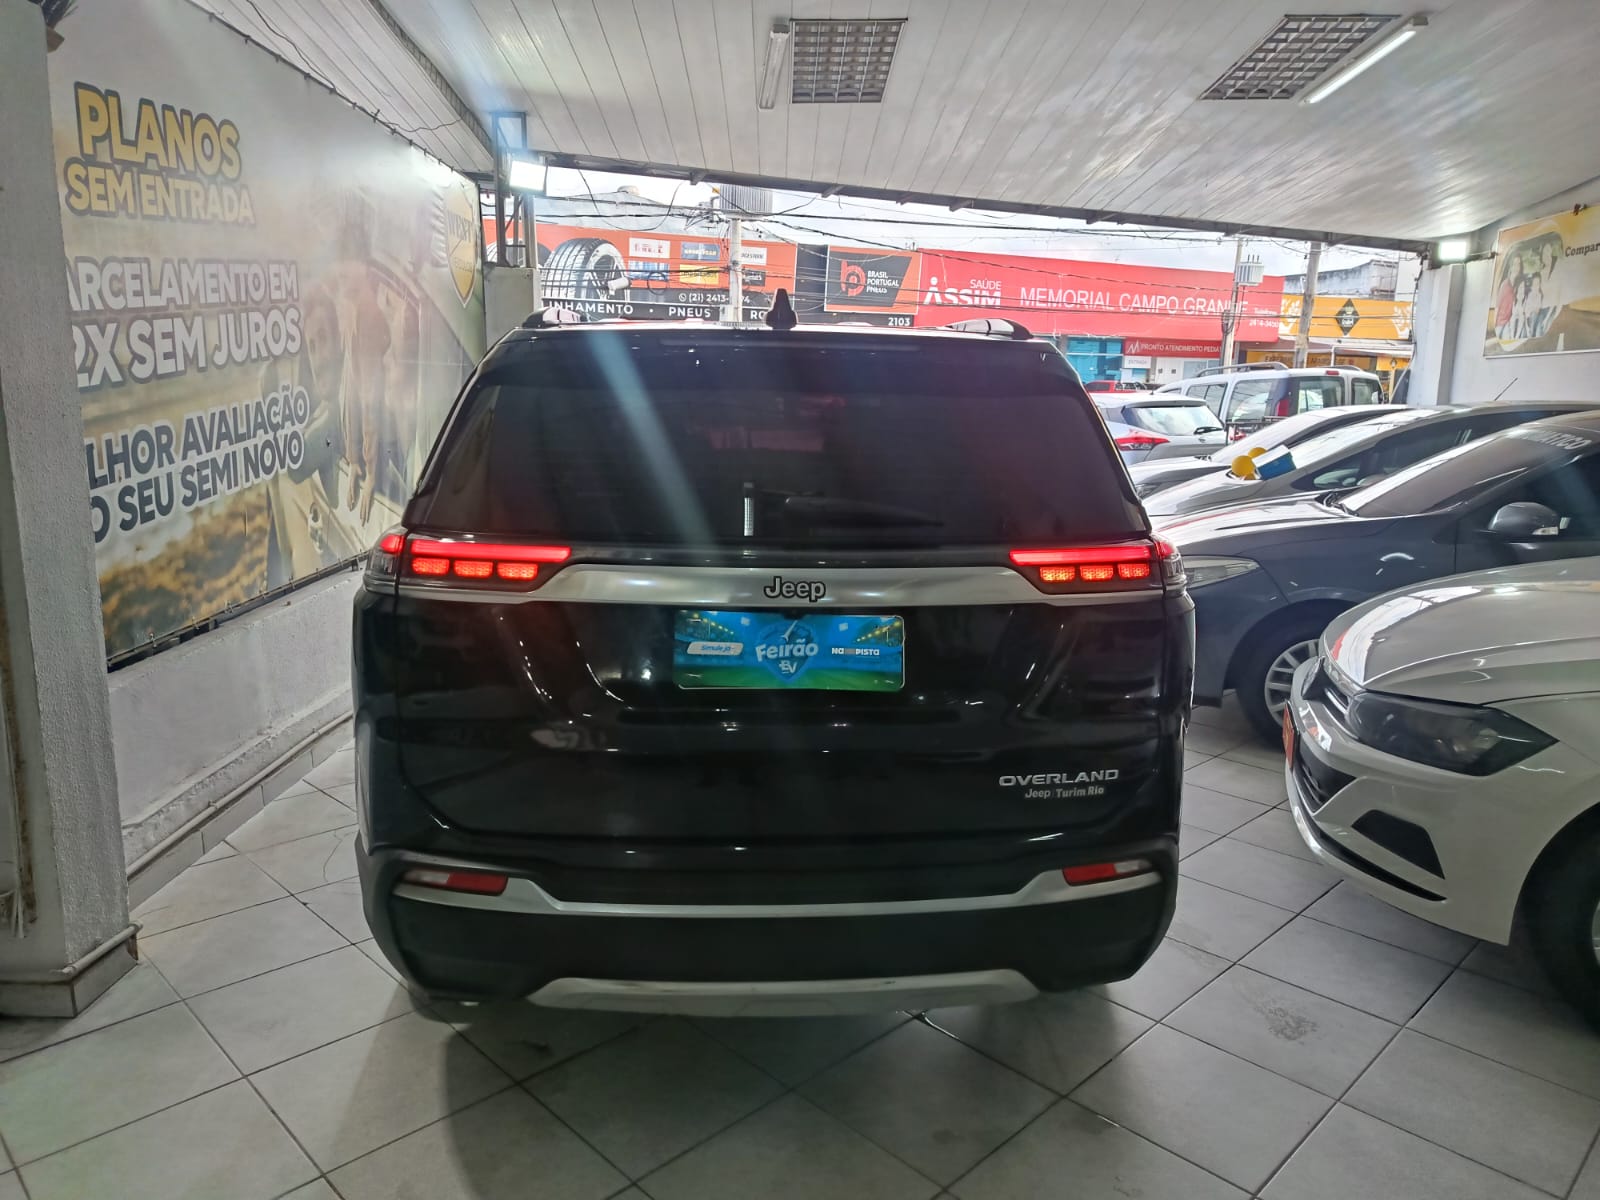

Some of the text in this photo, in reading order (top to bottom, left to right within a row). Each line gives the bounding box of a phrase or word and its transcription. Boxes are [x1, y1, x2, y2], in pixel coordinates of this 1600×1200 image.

[75, 83, 241, 182] PLANOS
[65, 159, 256, 225] SEM ENTRADA
[268, 261, 299, 301] EM
[866, 278, 900, 287] PORTUGAL
[867, 270, 888, 279] BRASIL
[970, 279, 1002, 290] SAÚDE
[923, 277, 1002, 307] ASSIM
[1020, 287, 1115, 309] MEMORIAL
[1119, 293, 1179, 313] CAMPO
[669, 307, 712, 318] PNEUS
[888, 317, 911, 327] 2103
[129, 315, 207, 380] SEM
[213, 307, 301, 367] JUROS
[1141, 343, 1164, 351] PRONTO
[1165, 344, 1203, 352] ATENDIMENTO
[181, 384, 309, 461] AVALIAÇÃO
[117, 472, 175, 532] SEU
[181, 452, 239, 508] SEMI
[244, 430, 304, 480] NOVO
[764, 576, 826, 602] Jeep
[755, 638, 819, 662] Feirão
[999, 769, 1119, 786] OVERLAND
[1025, 785, 1105, 799] Jeep Turim Rio
